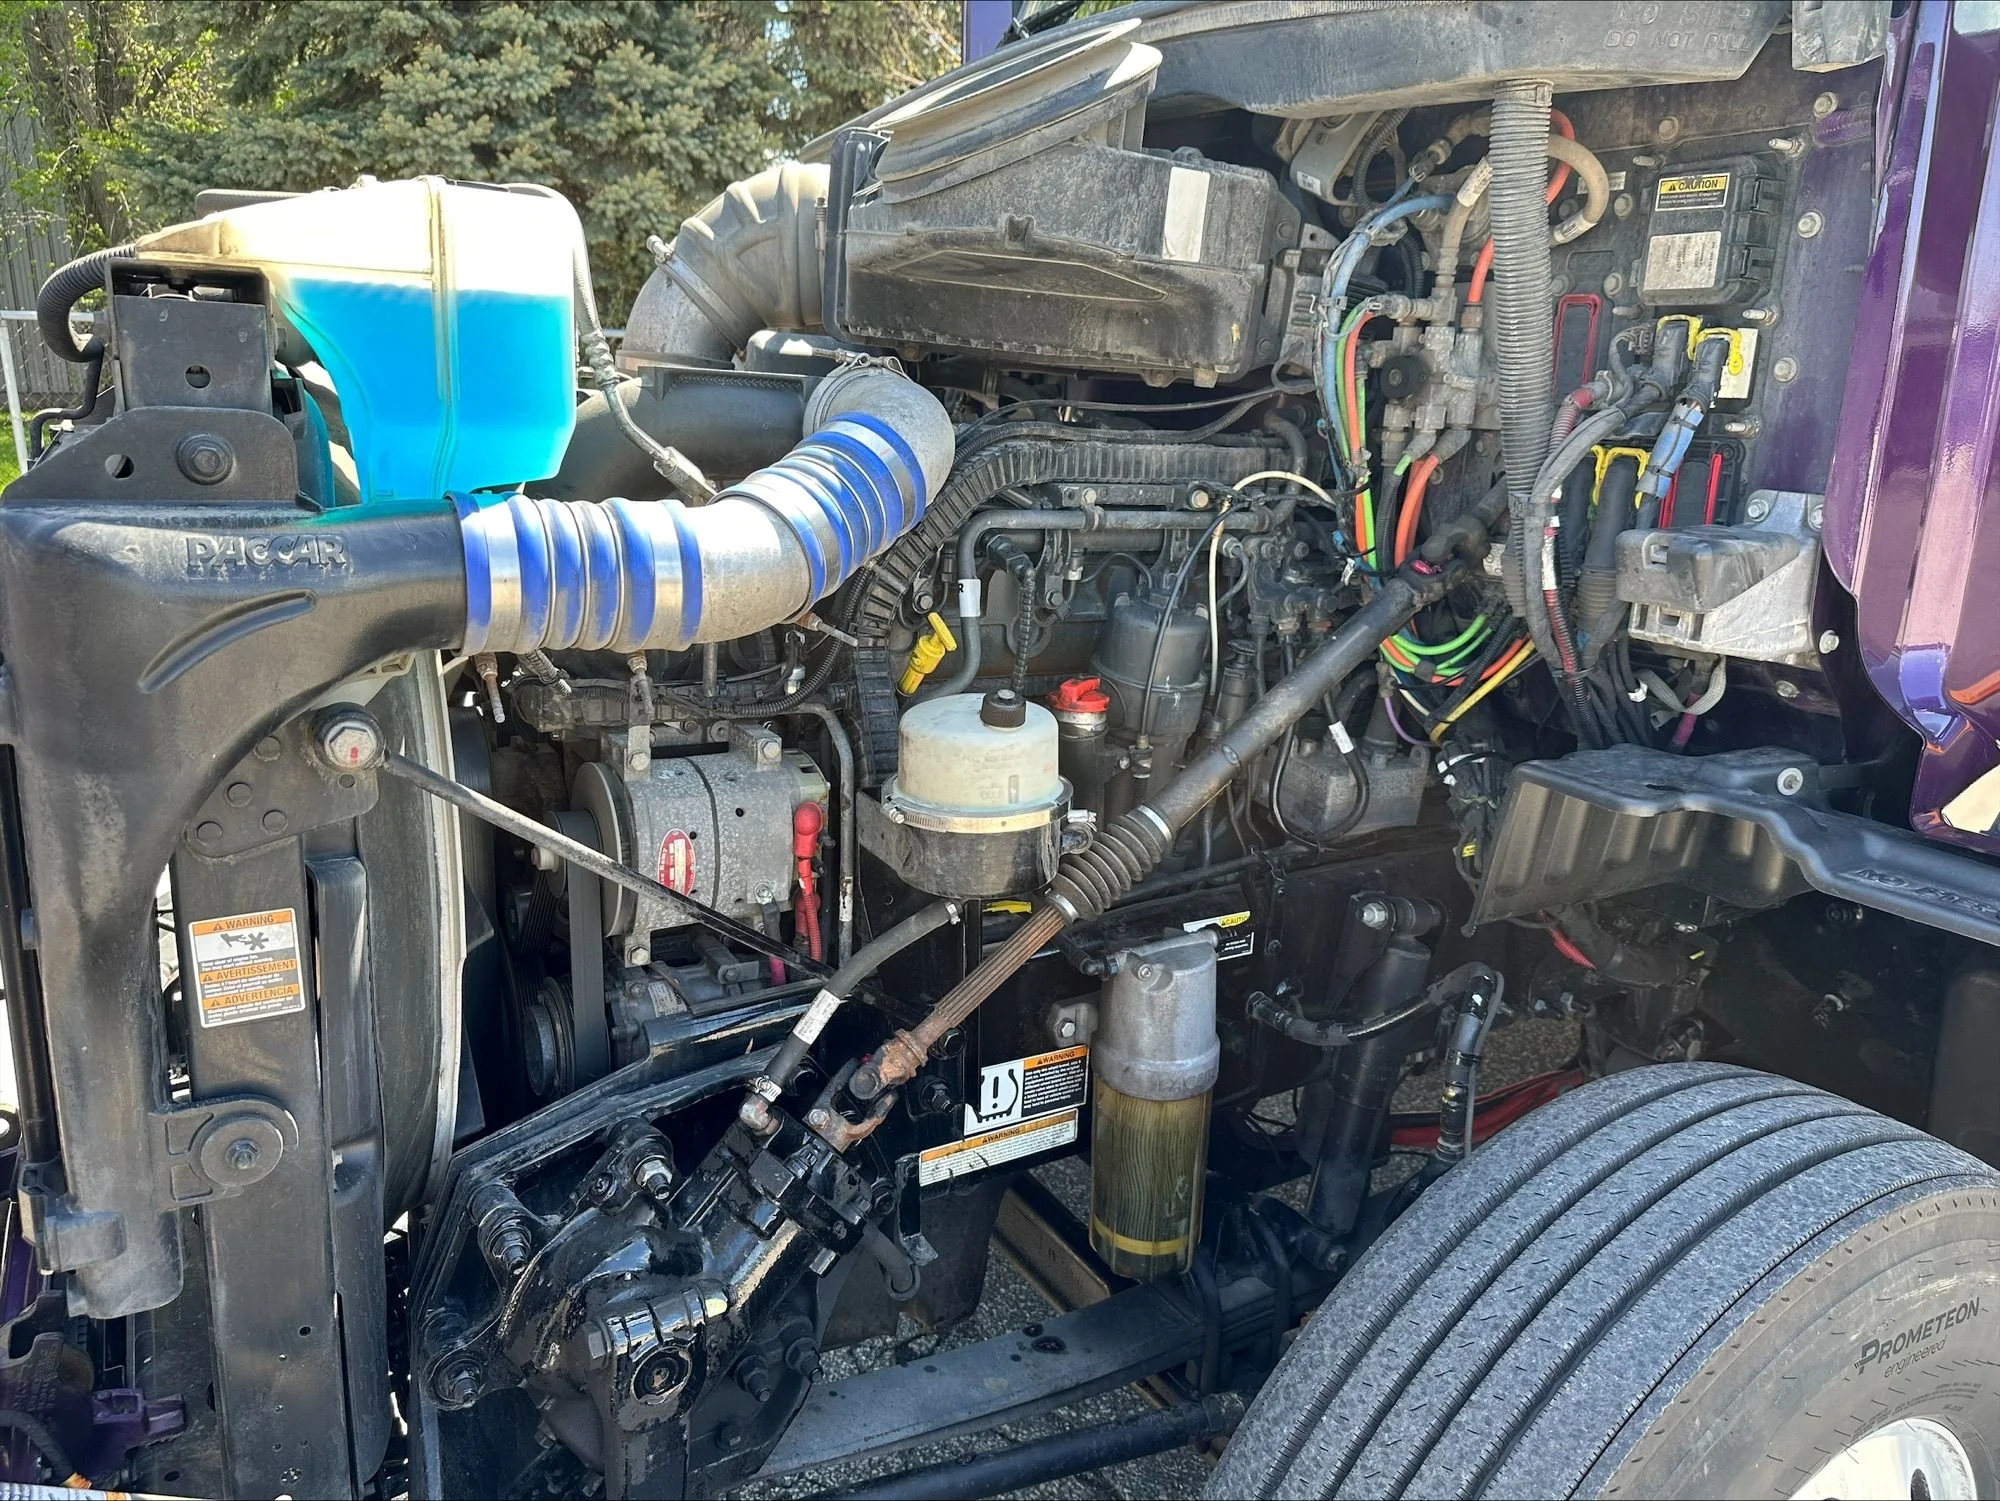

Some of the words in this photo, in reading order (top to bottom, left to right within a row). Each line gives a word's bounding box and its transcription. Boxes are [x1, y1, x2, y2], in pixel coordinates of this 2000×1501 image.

[1604, 30, 1639, 48] DO
[1678, 180, 1718, 191] CAUTION
[186, 535, 347, 568] PACCAR
[226, 914, 274, 929] WARNING
[216, 959, 294, 980] AVERTISSEMENT
[224, 986, 293, 1005] ADVERTENCIA
[1043, 1051, 1075, 1063] WARNING
[986, 1129, 1020, 1143] WARNING
[1855, 1297, 1980, 1375] PROMETEON
[1884, 1334, 1948, 1378] engineered
